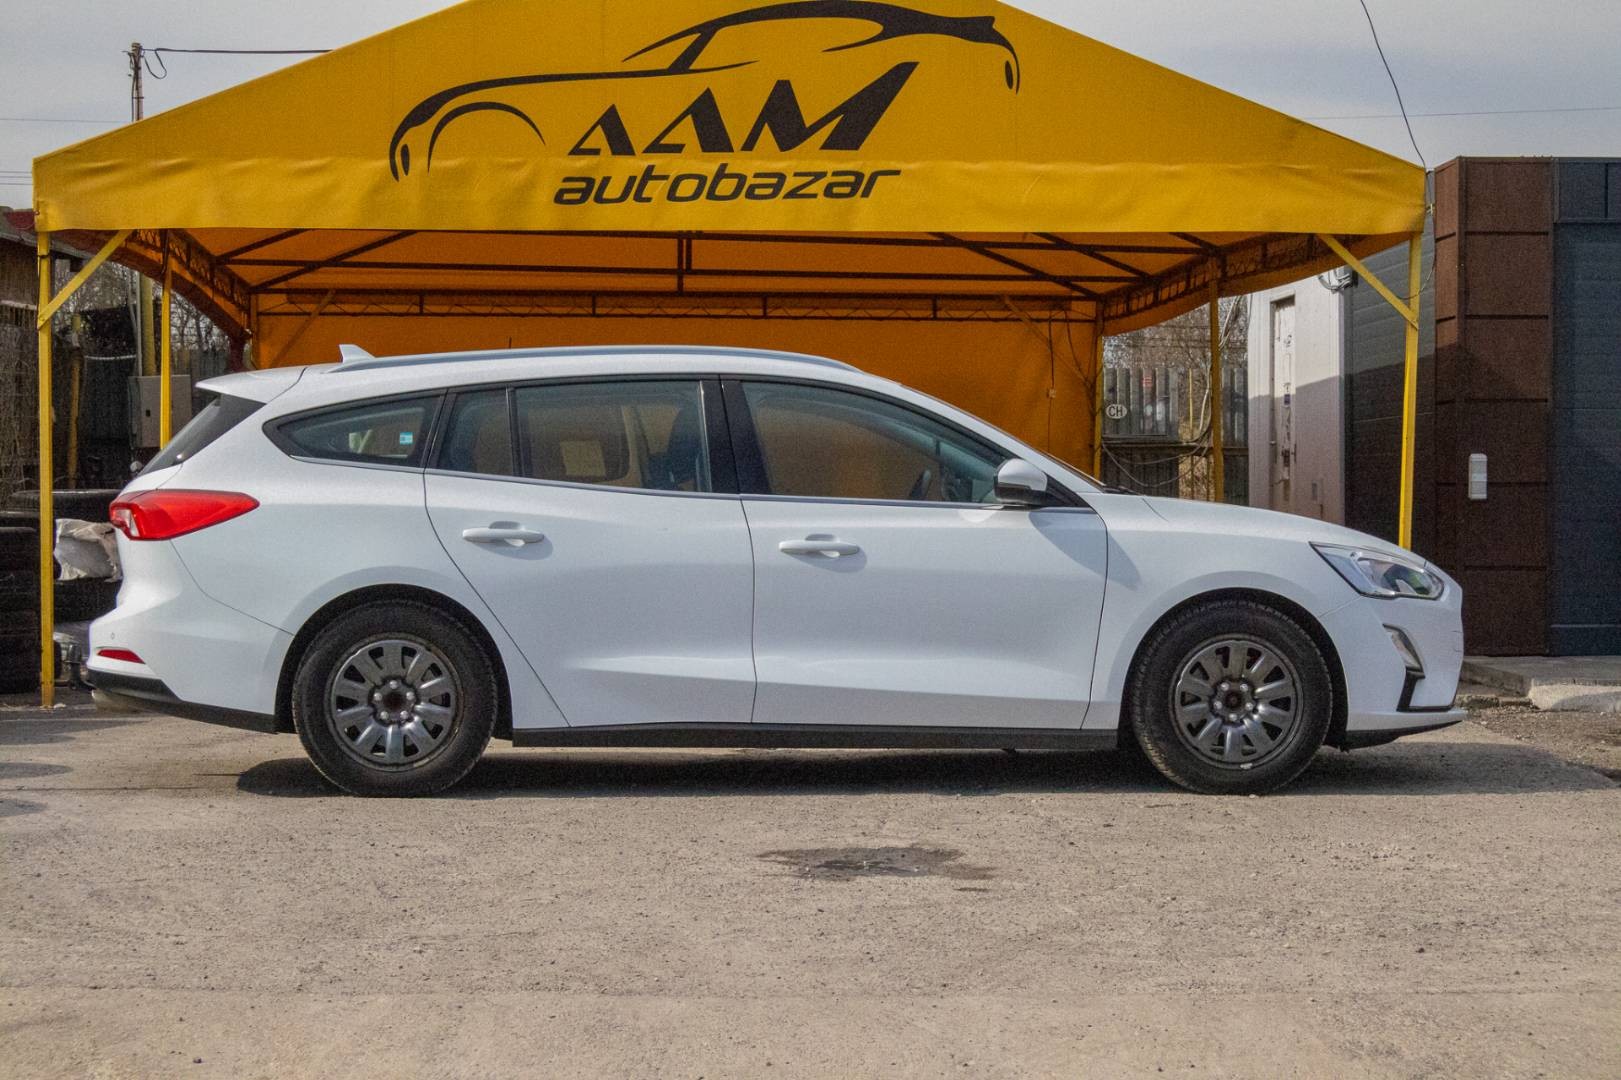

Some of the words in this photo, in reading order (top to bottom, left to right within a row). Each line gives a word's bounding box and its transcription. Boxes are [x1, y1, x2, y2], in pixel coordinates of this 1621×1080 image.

[567, 61, 920, 156] AAM
[553, 163, 902, 206] autobazar
[1108, 404, 1123, 417] CH
